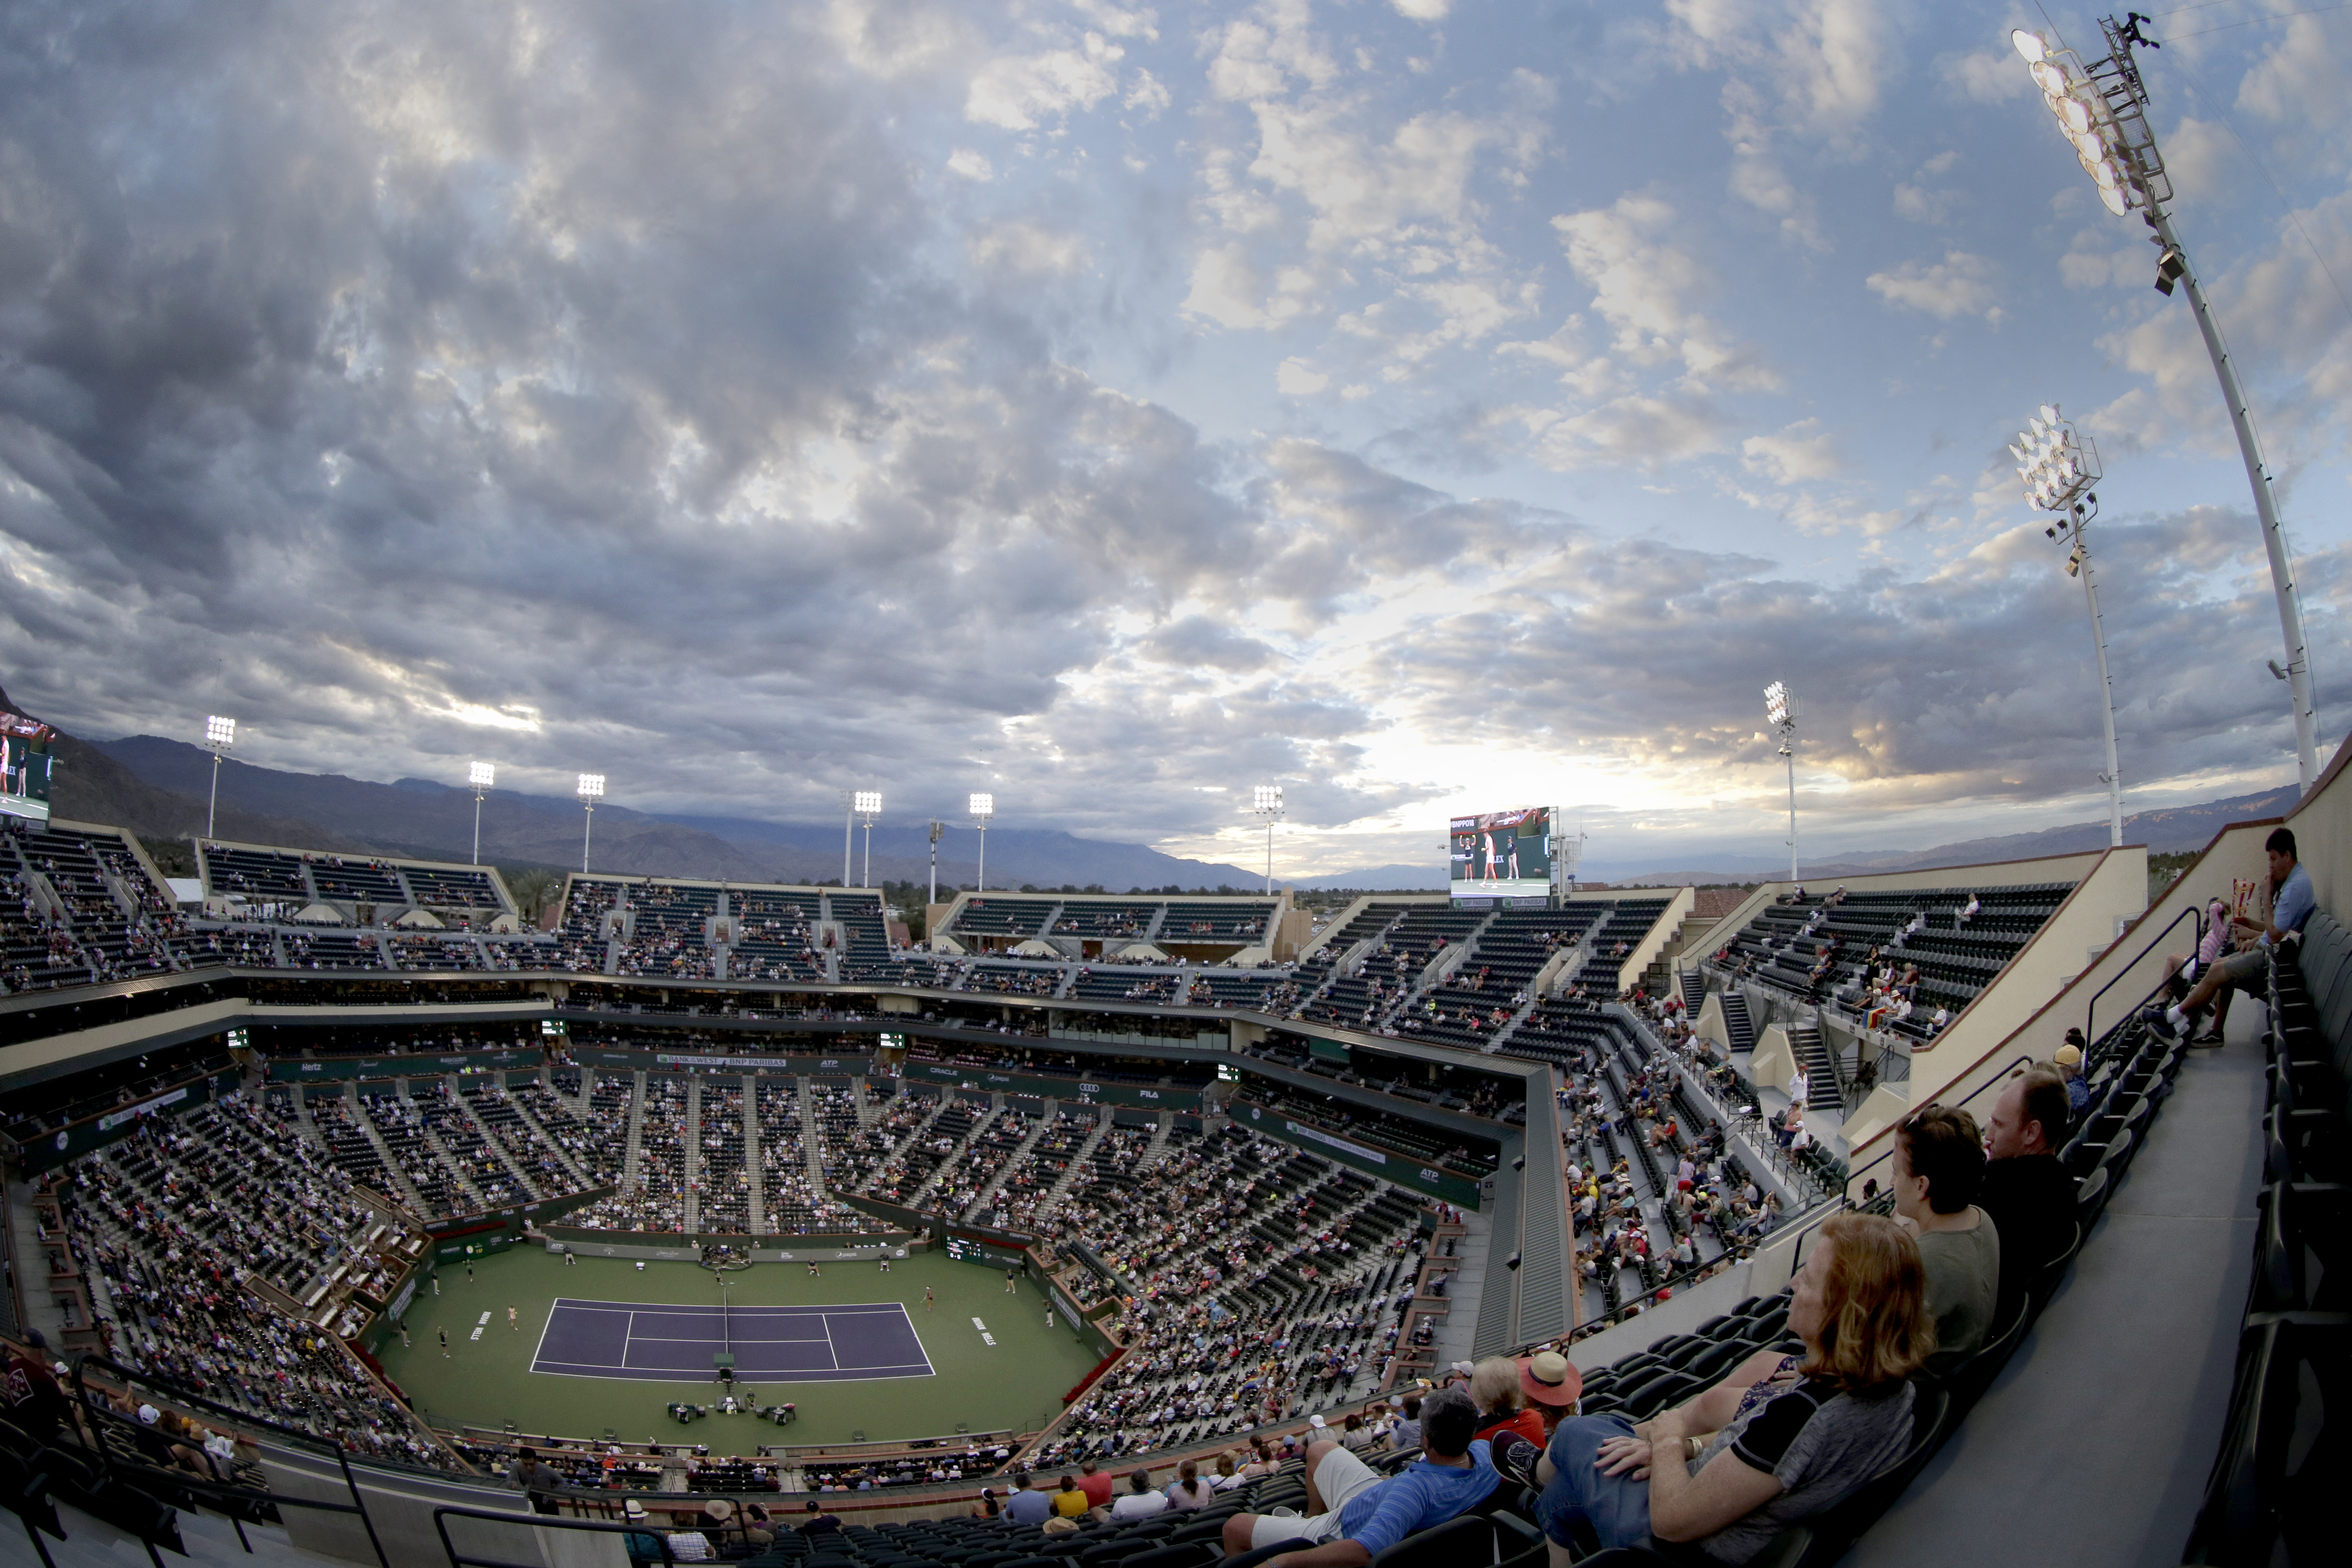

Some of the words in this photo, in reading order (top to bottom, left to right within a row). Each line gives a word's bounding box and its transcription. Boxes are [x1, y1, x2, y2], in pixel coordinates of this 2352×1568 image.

[930, 1068, 958, 1076] ORACLE
[1140, 1090, 1159, 1098] FILA
[1308, 1130, 1325, 1141] PARIBAS
[1421, 1168, 1438, 1178] ATP
[478, 1311, 491, 1324] INDIAN
[971, 1317, 986, 1330] INDIAN
[470, 1327, 484, 1340] WELLS
[981, 1332, 996, 1345] WELLS
[13, 1375, 24, 1383] SALTY
[11, 1389, 21, 1397] CREW
